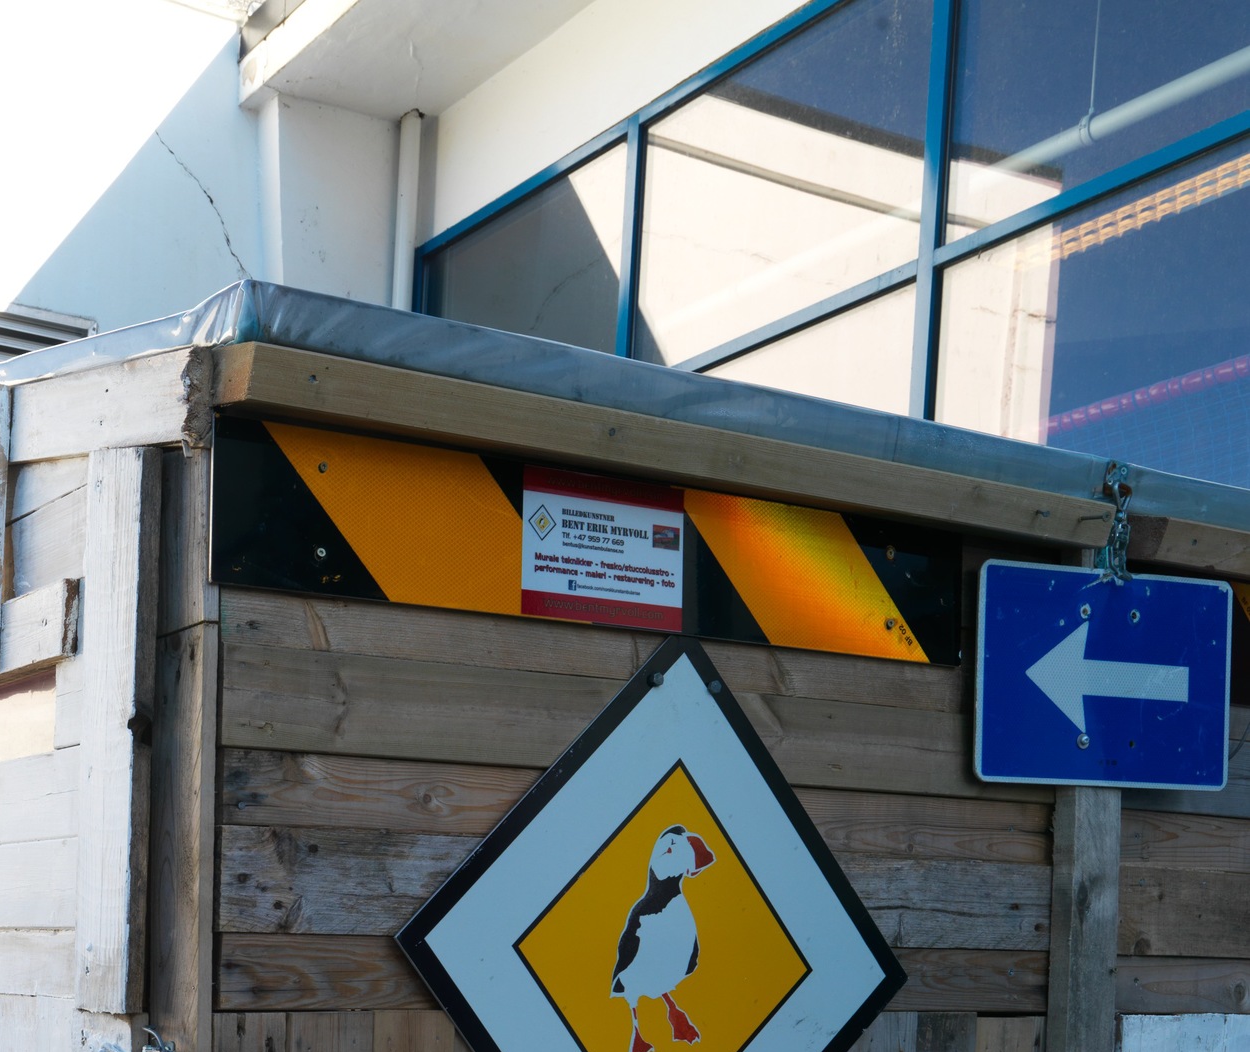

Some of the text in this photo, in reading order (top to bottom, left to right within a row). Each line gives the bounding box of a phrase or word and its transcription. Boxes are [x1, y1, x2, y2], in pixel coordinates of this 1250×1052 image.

[562, 508, 615, 523] BILLEDKUNSTNER
[562, 518, 649, 540] BENT ERIK MYRVOLL
[573, 534, 586, 542] +47
[587, 535, 600, 543] 959
[602, 537, 611, 545] 77
[611, 538, 625, 546] 669
[534, 551, 559, 564] Murale
[534, 564, 676, 588] performance maleri restaurering foto
[545, 599, 664, 620] www.bentmyrvoll.com
